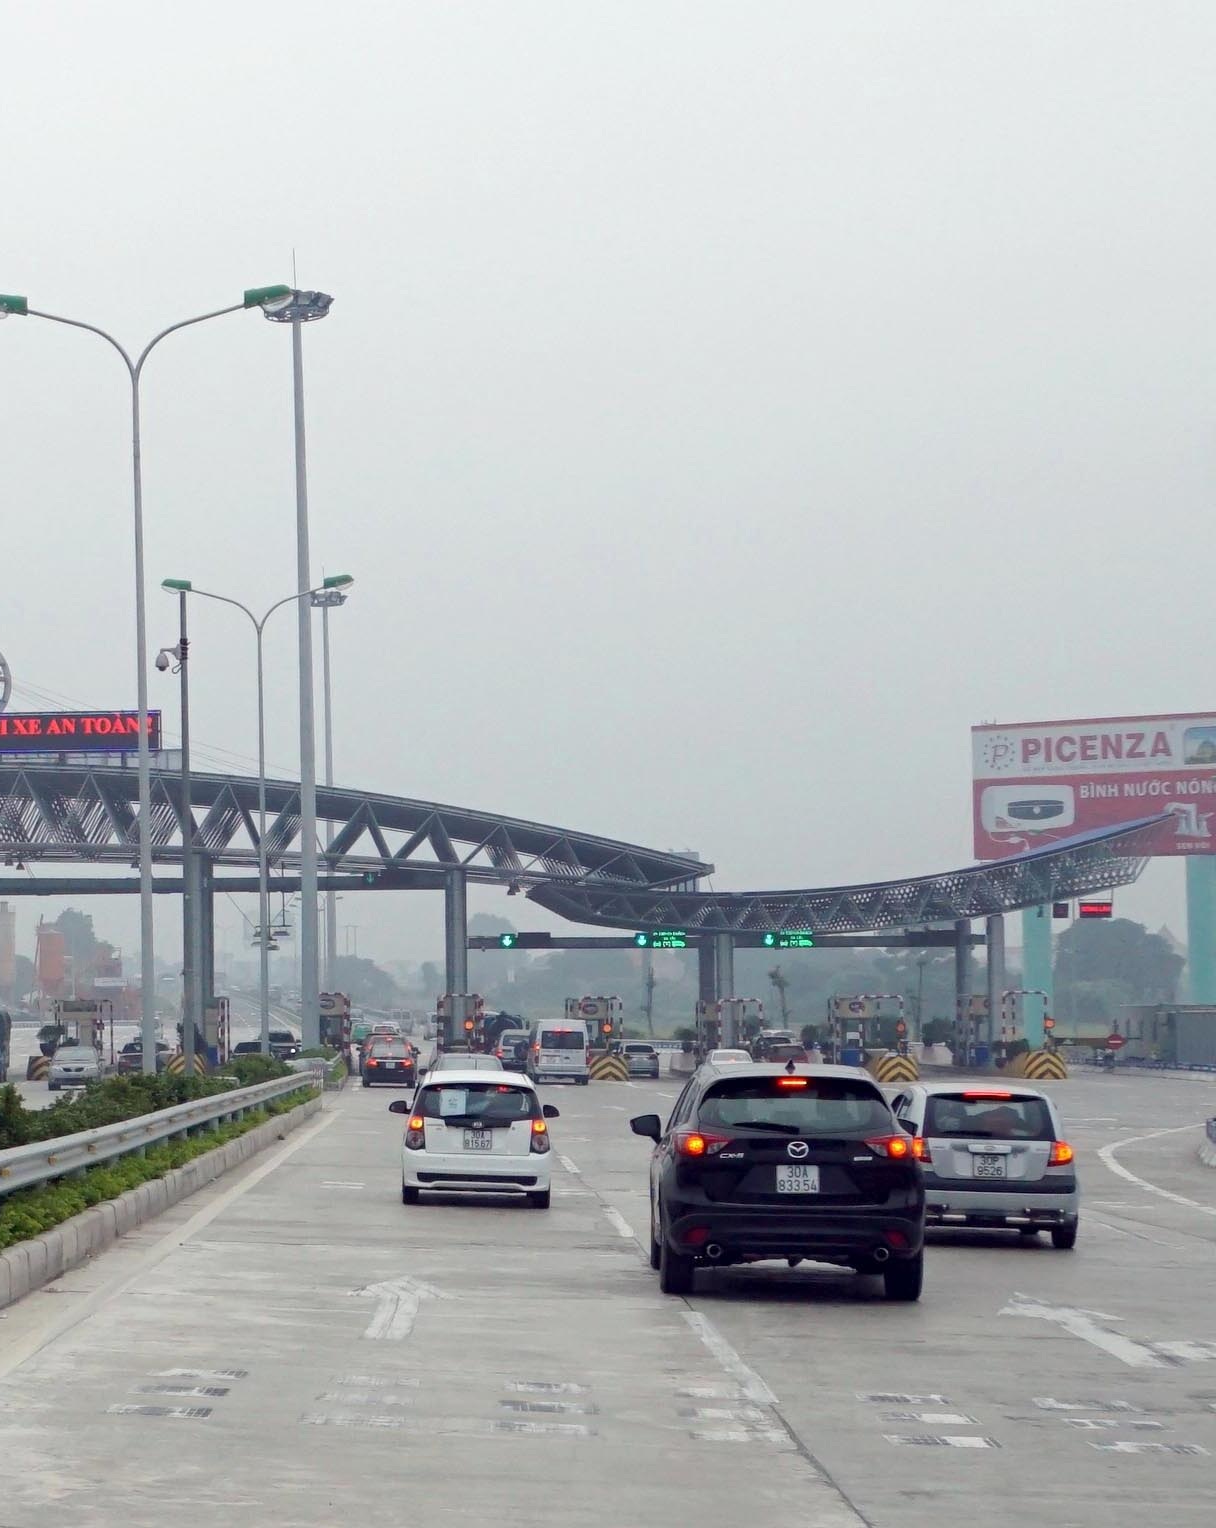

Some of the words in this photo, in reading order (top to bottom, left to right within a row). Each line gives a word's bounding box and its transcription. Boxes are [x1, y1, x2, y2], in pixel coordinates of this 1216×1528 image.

[13, 718, 41, 735] XE
[46, 718, 75, 735] AN
[1021, 731, 1172, 763] PICENZA
[1080, 782, 1119, 799] BÌNH
[1124, 779, 1172, 797] NƯỚC
[786, 1166, 809, 1178] 30A
[977, 1165, 1003, 1176] 9526
